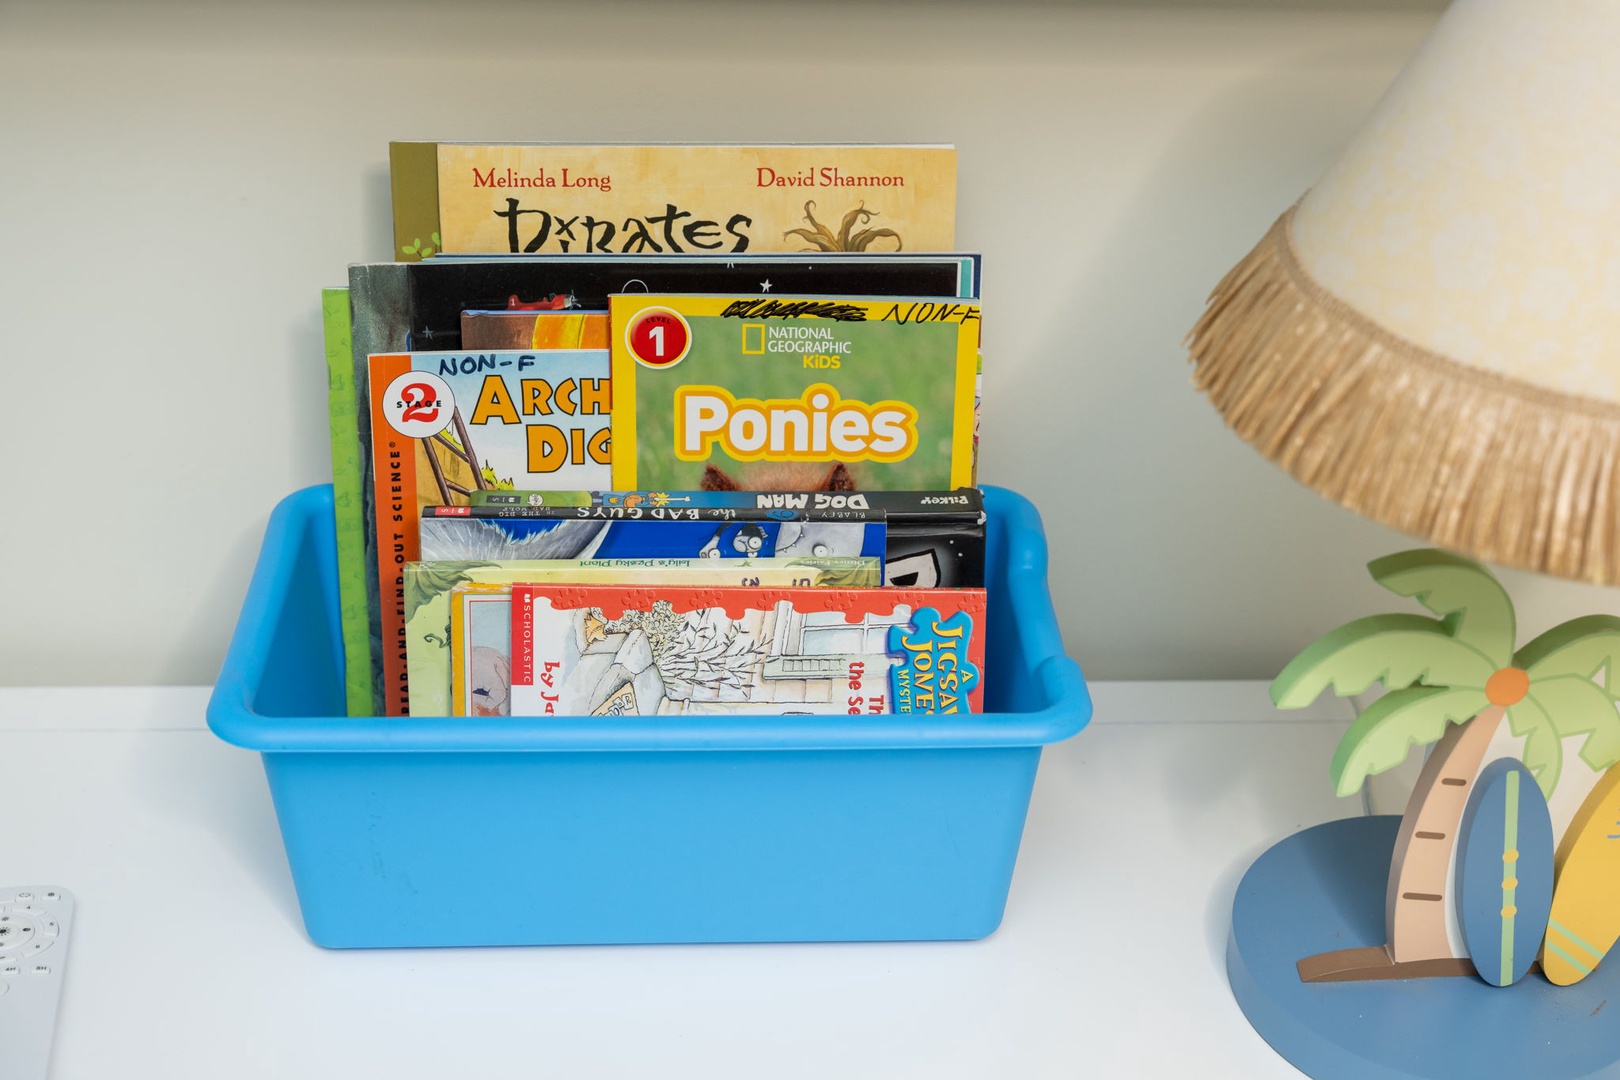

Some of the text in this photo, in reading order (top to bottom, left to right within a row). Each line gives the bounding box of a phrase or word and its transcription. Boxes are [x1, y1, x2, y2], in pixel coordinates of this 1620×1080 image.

[472, 167, 612, 192] Melinda Long
[756, 167, 905, 188] David Shannon
[645, 316, 672, 325] LEVEL
[648, 326, 666, 357] 1
[768, 327, 835, 340] NATIONAL
[767, 340, 852, 354] GEOGRAPHIC
[396, 399, 443, 409] STAGE
[400, 382, 440, 423] 2
[470, 375, 612, 425] ARCH
[681, 388, 912, 457] Ponies
[757, 493, 810, 510] MAN
[813, 492, 870, 510] DOG
[577, 506, 643, 520] GUYS
[650, 506, 700, 520] BAD
[707, 508, 736, 521] the
[821, 508, 866, 520] BLABEY
[580, 560, 611, 568] Plant
[615, 560, 652, 568] Pesky
[523, 605, 531, 683] SCHOLASTIC
[540, 661, 561, 688] by
[848, 661, 865, 691] the
[901, 635, 936, 714] JONE
[960, 670, 974, 684] A
[897, 669, 912, 714] MYSTE
